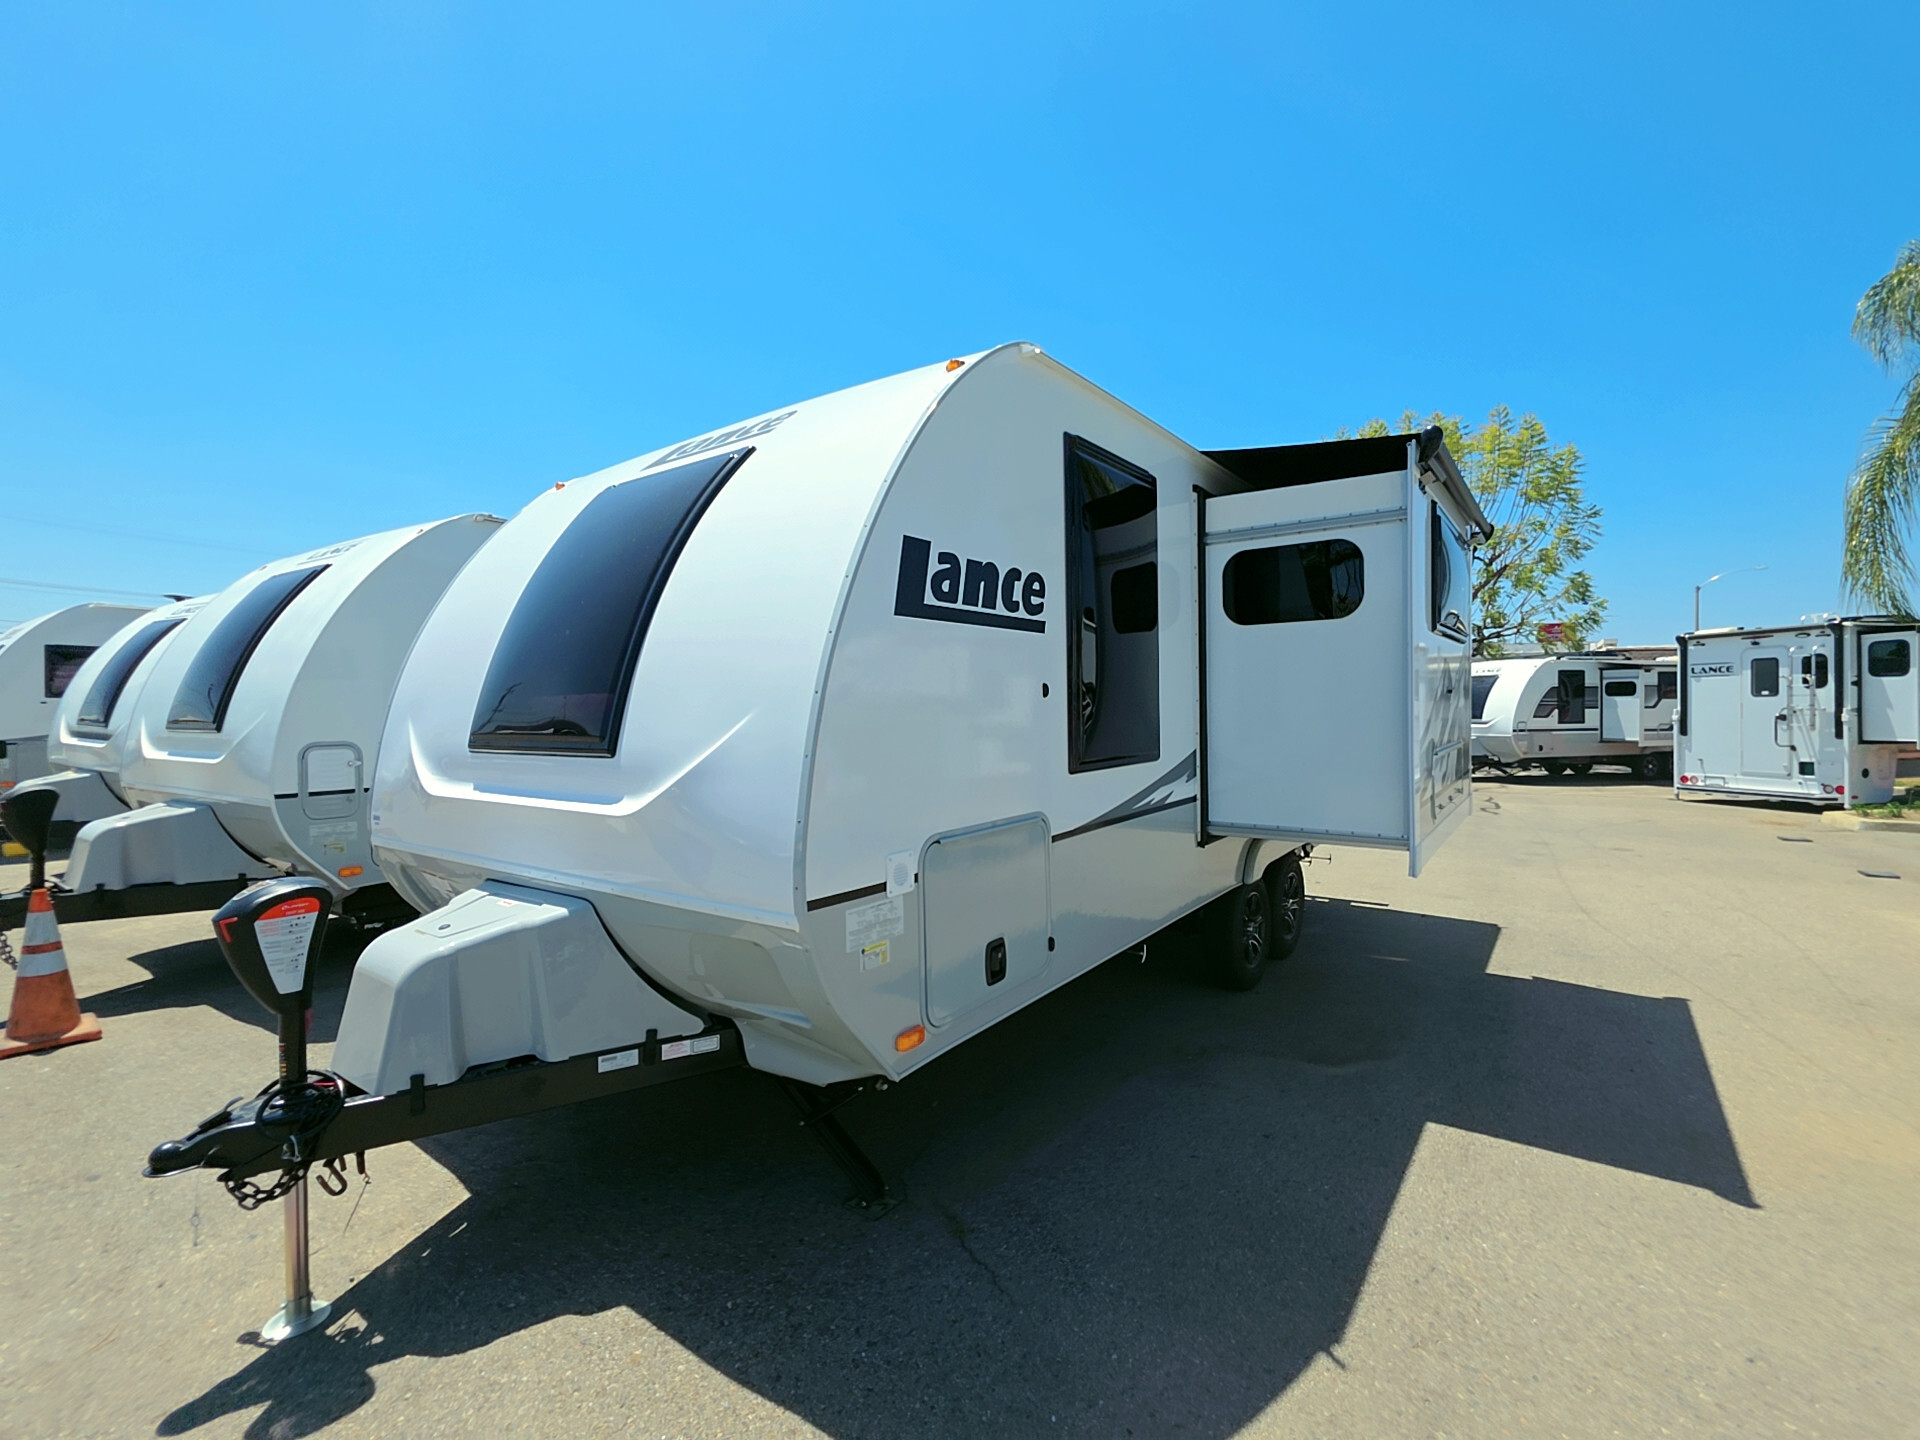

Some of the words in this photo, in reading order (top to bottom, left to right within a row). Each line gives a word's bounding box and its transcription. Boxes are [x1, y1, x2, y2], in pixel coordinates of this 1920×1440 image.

[640, 410, 798, 471] Lance
[894, 535, 1046, 634] Lance
[1690, 665, 1735, 675] LANCE
